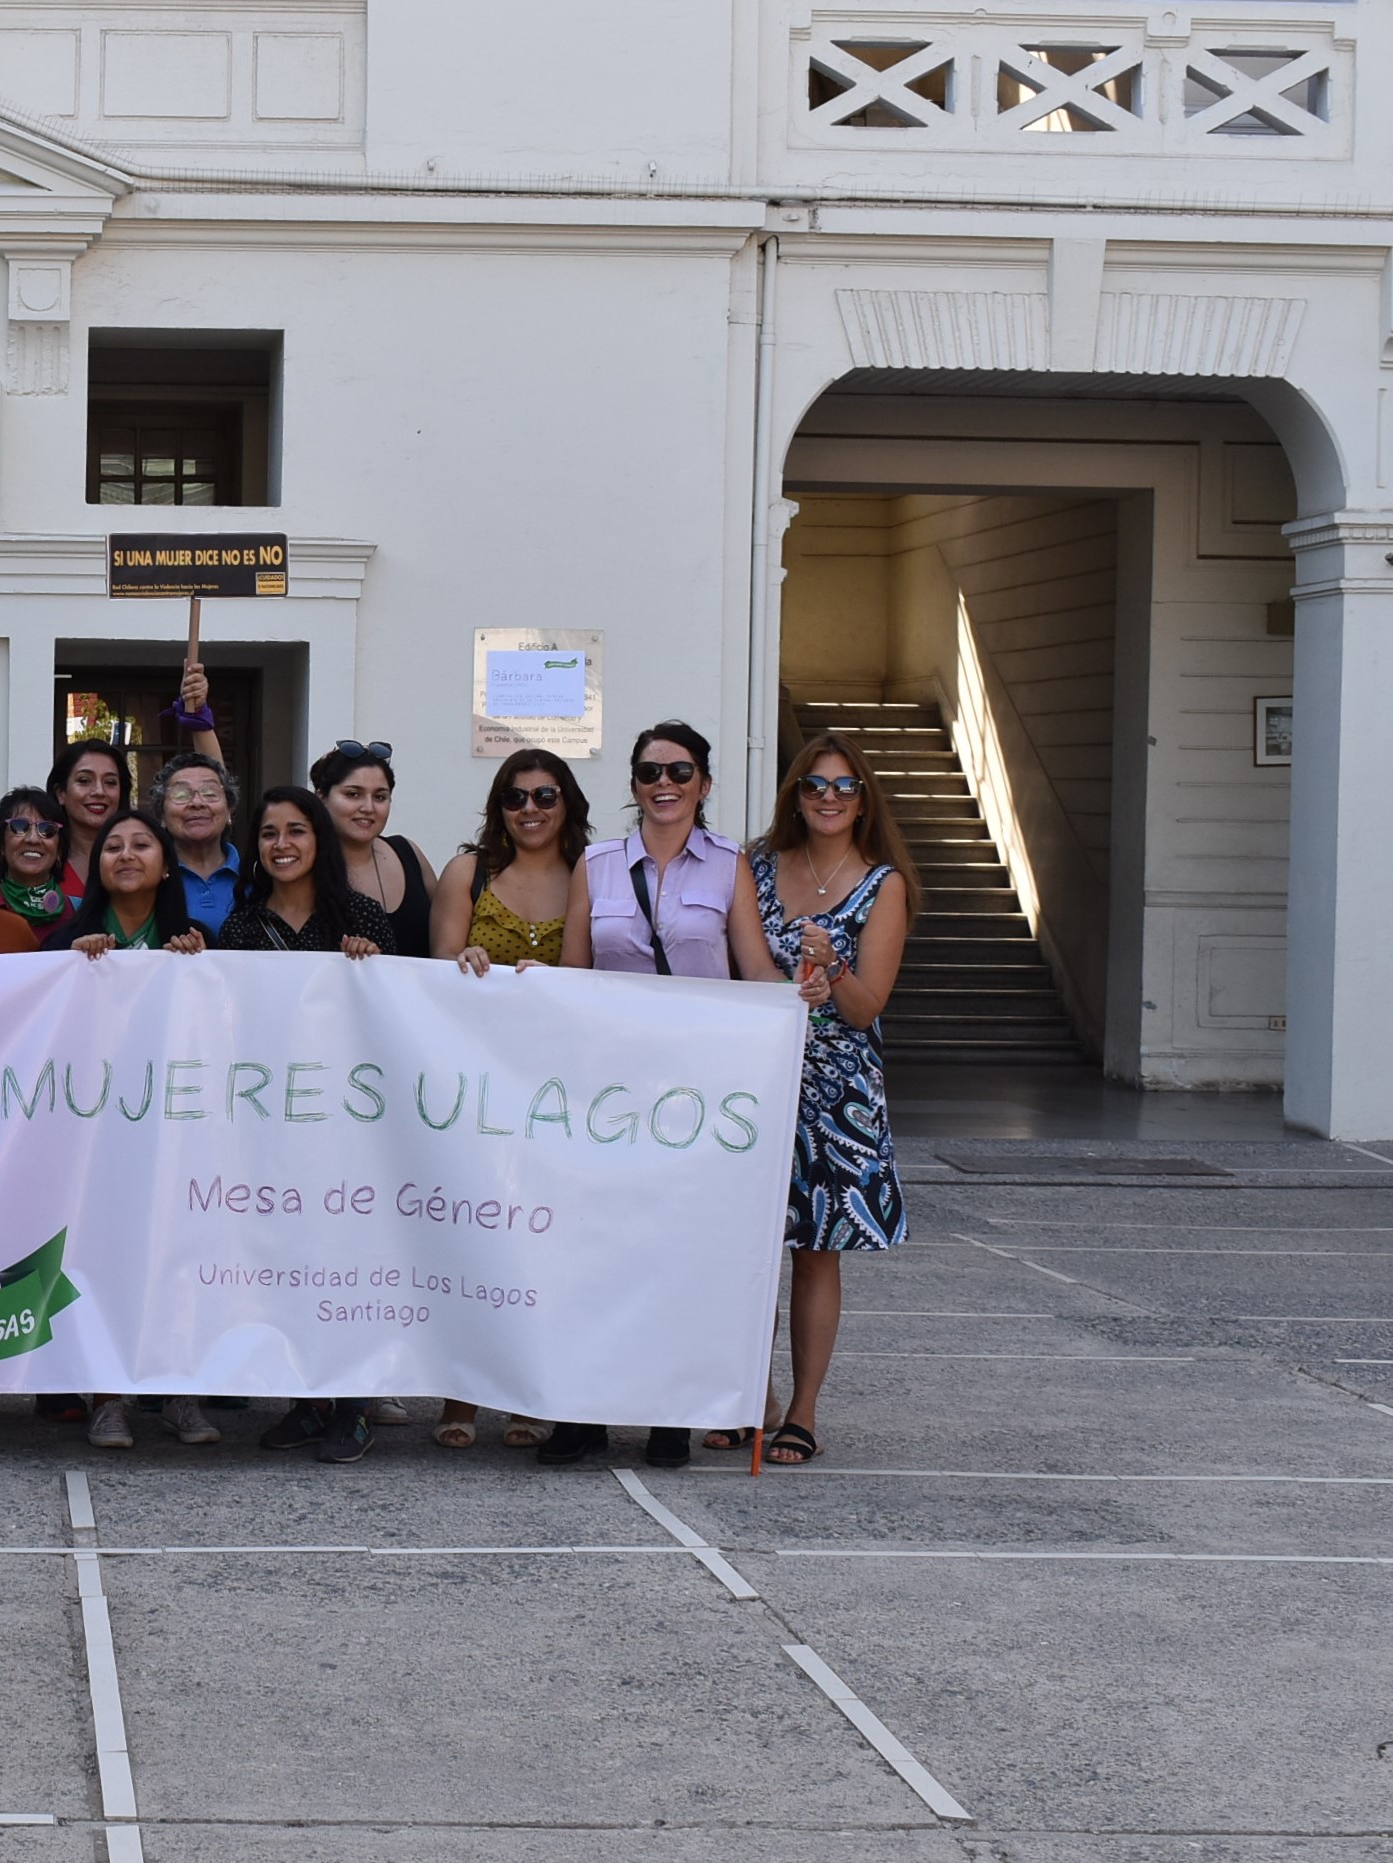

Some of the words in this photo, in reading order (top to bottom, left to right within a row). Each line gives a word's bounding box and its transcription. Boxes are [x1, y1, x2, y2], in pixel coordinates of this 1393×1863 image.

[113, 550, 123, 566] SI
[126, 550, 153, 566] UNA
[156, 550, 192, 566] MUJER
[195, 550, 219, 566] DICE
[222, 549, 241, 566] NO
[243, 549, 256, 565] ES
[259, 545, 283, 565] NO
[550, 642, 559, 652] A
[0, 1057, 387, 1124] MUJERES
[188, 1174, 303, 1217] Mesa
[323, 1180, 376, 1215] de
[396, 1182, 554, 1234] Género
[199, 1263, 358, 1288] Universidad
[369, 1266, 401, 1288] de
[412, 1265, 452, 1294] Los
[461, 1275, 538, 1310] Lagos
[316, 1299, 430, 1328] Santiago
